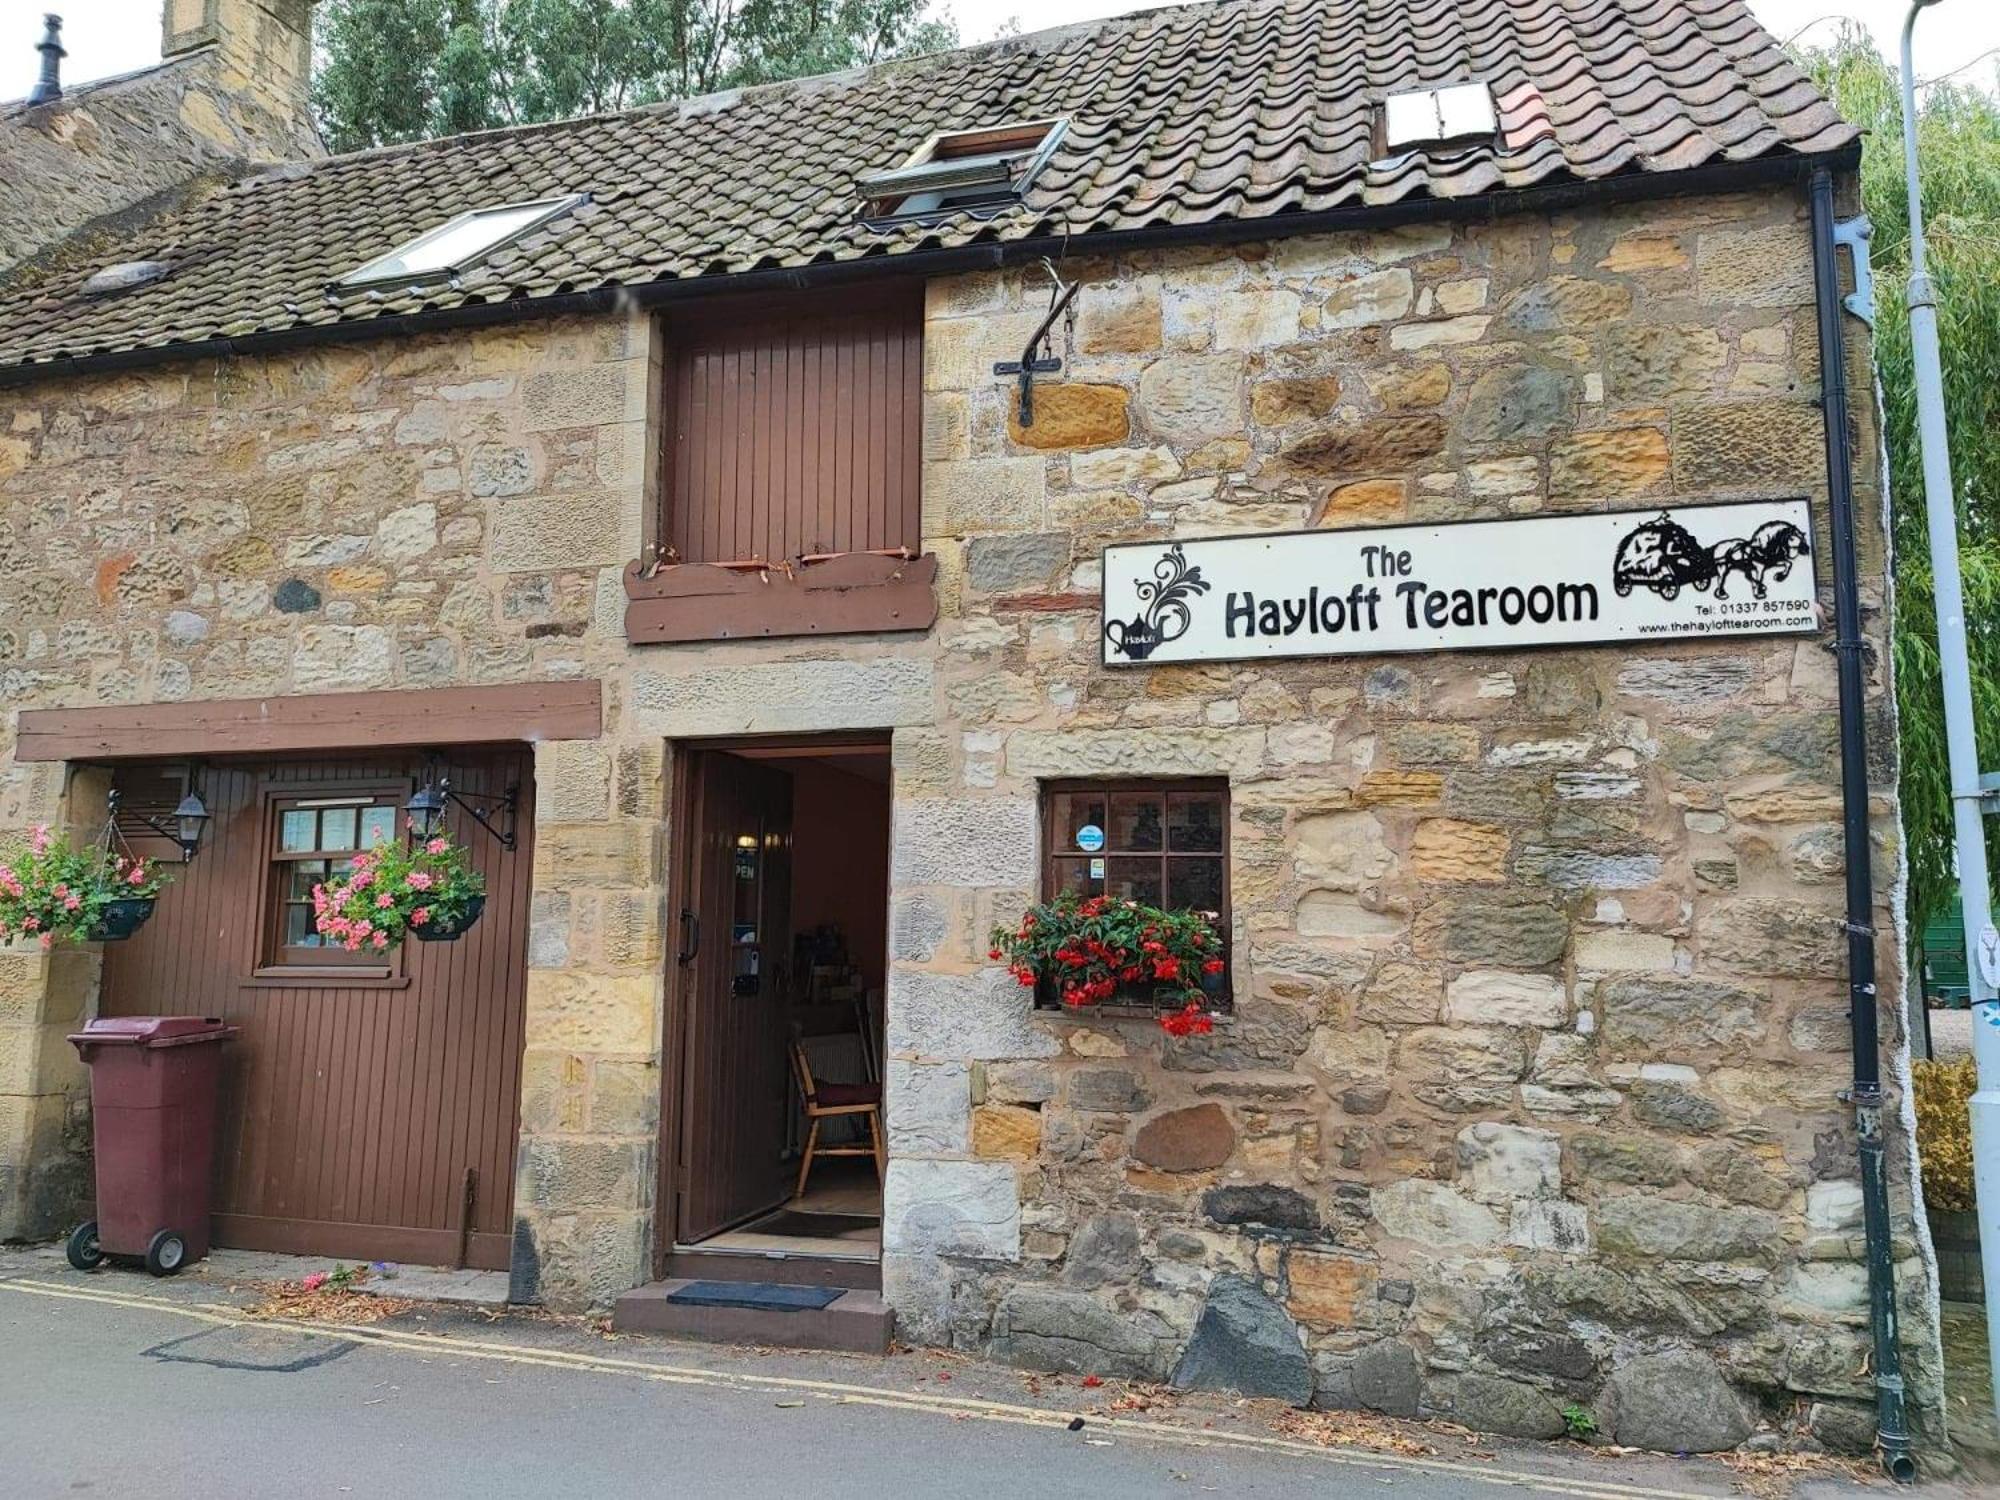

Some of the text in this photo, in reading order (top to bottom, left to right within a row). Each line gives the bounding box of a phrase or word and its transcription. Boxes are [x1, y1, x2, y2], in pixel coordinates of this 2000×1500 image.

[1361, 545, 1412, 577] The
[1225, 581, 1599, 638] Hayloft Tearoom
[1695, 604, 1715, 616] Tel:
[1720, 602, 1757, 614] 01337
[1638, 616, 1813, 634] www.thehaylofttearoom.com
